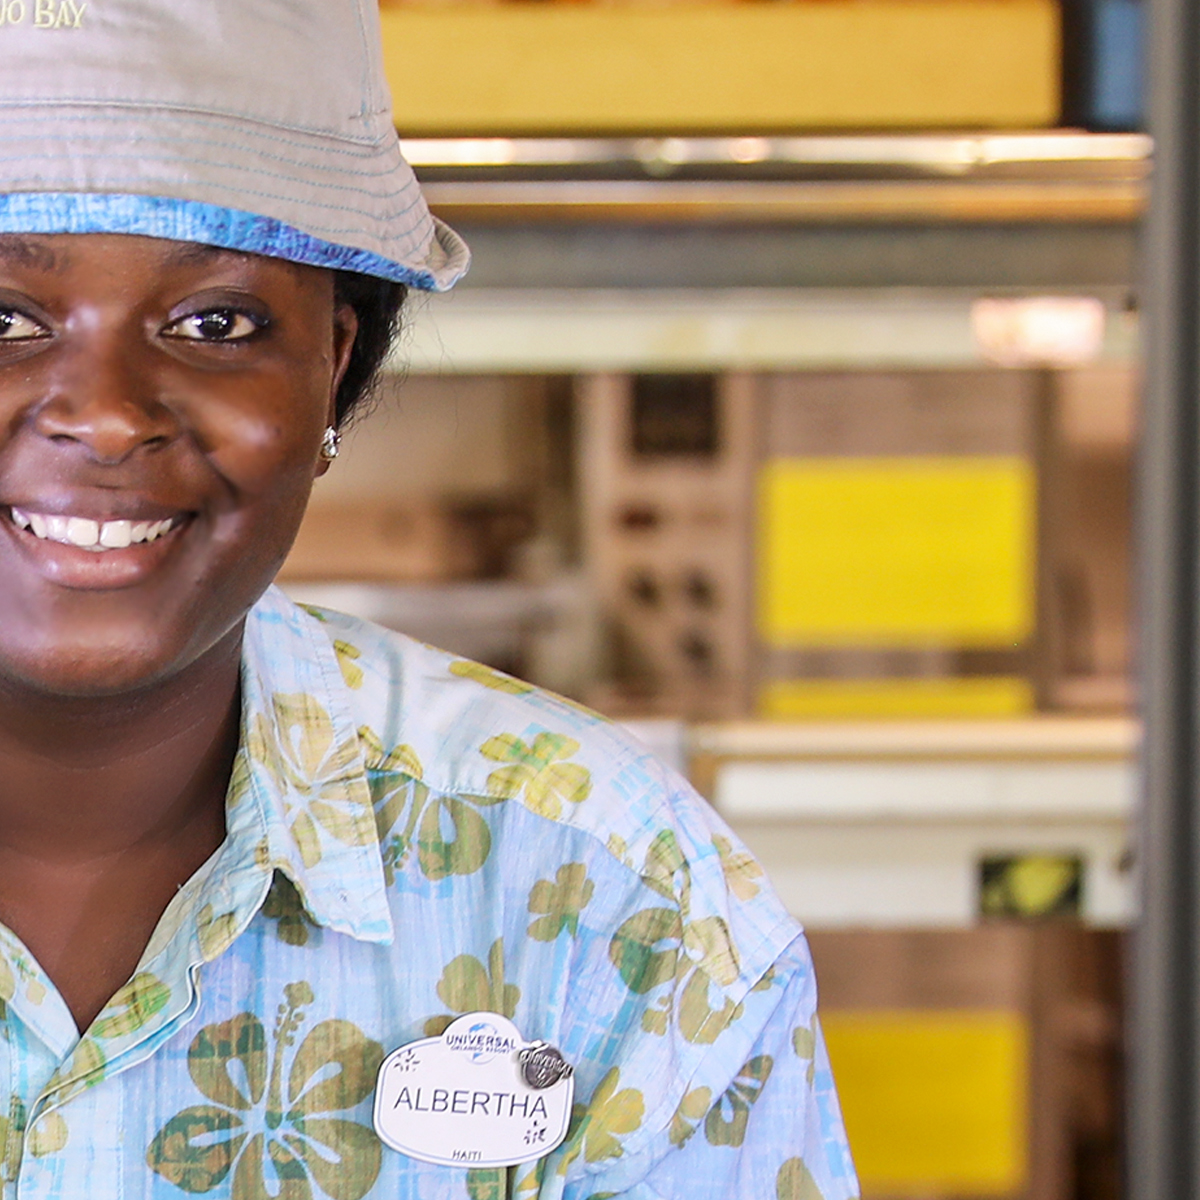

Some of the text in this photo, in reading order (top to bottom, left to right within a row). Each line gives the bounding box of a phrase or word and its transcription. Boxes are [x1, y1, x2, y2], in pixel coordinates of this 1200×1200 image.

[34, 0, 87, 29] BAY
[446, 1034, 516, 1050] UNIVERSAL
[393, 1086, 548, 1119] ALBERTHA
[452, 1149, 482, 1160] HAITI
